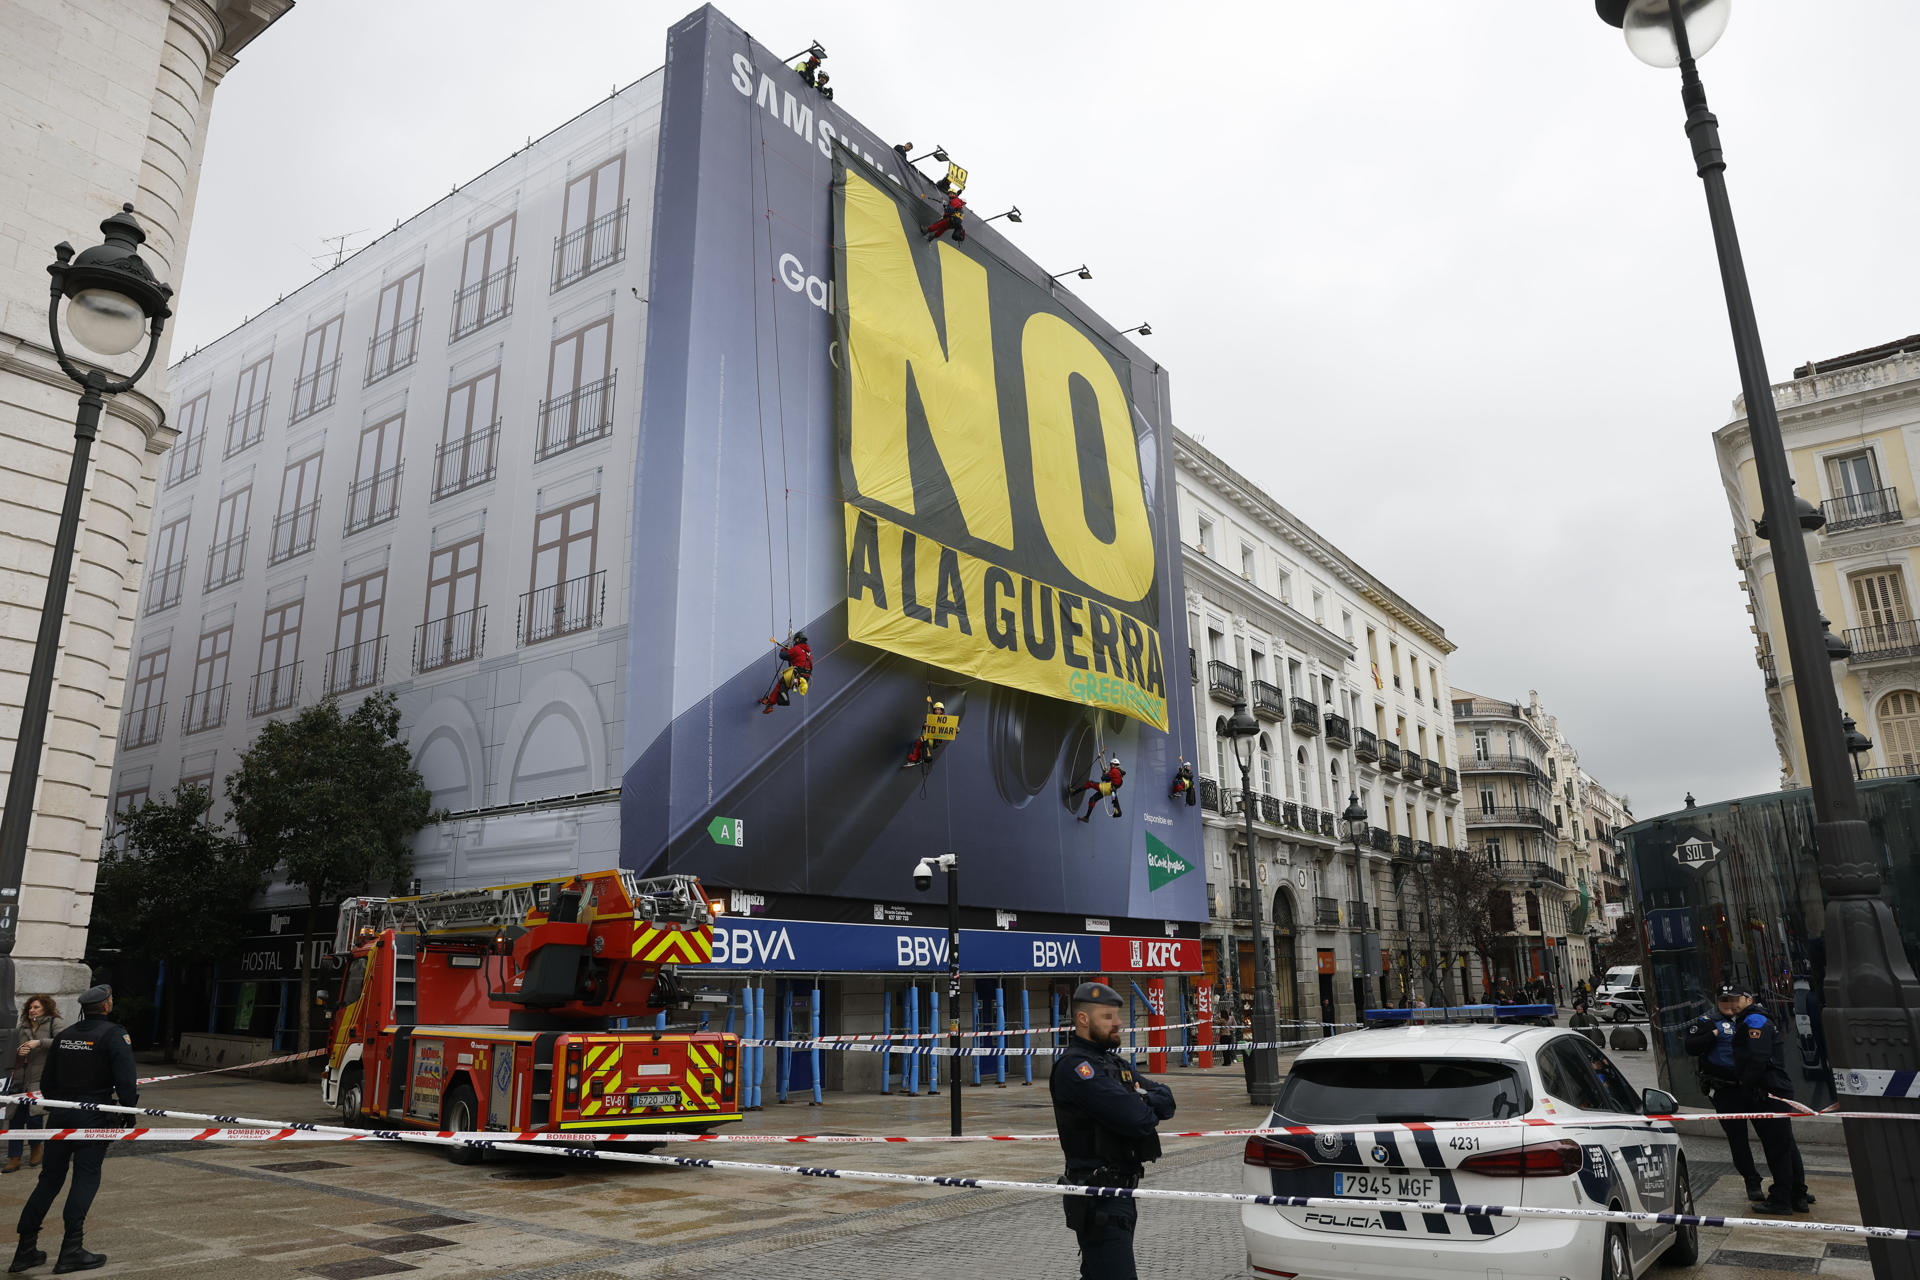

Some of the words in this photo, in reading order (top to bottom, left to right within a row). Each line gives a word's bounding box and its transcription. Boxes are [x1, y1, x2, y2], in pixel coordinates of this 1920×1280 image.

[731, 52, 902, 186] SAMS
[949, 163, 967, 182] NO
[844, 167, 1156, 603] NO
[848, 511, 889, 611] A
[900, 529, 973, 636] LA
[984, 565, 1166, 699] GUERRA
[936, 715, 948, 724] NO
[927, 725, 937, 734] TO
[938, 726, 955, 736] WAR
[720, 824, 731, 841] A
[736, 837, 742, 846] G
[1685, 844, 1706, 861] SOL
[711, 926, 796, 964] BBVA
[1032, 938, 1082, 968] BBVA
[241, 951, 283, 971] HOSTAL
[1146, 942, 1181, 967] KFC
[1198, 986, 1208, 1014] KFC
[605, 1095, 626, 1107] EV-61
[639, 1095, 659, 1106] 6720
[659, 1095, 676, 1105] JKP
[546, 1133, 598, 1141] BOMBEROS
[1449, 1137, 1480, 1151] 4231
[1346, 1175, 1392, 1195] 7945
[1398, 1178, 1434, 1197] MGF
[1304, 1212, 1383, 1230] POLICIA
